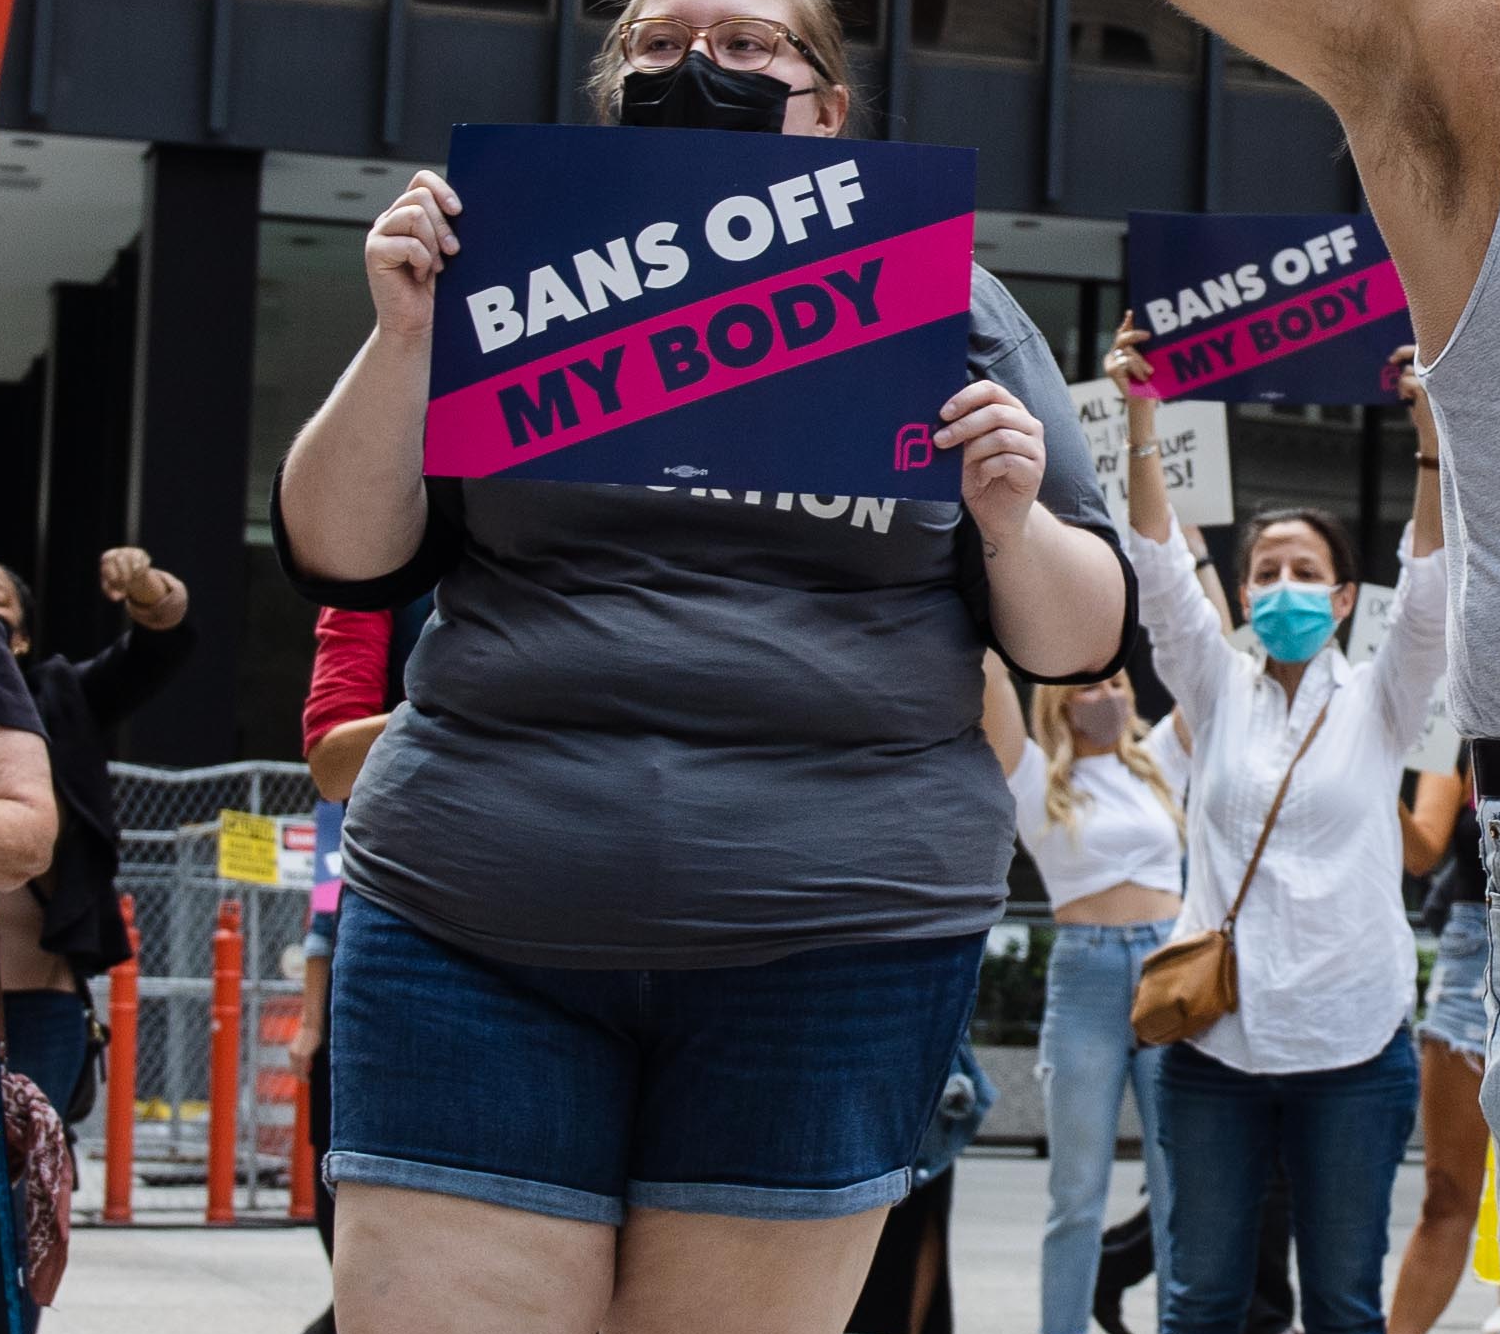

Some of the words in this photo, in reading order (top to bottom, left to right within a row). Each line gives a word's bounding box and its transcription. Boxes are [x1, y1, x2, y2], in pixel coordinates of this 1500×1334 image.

[466, 221, 690, 354] BANS
[705, 159, 864, 261] OFF
[1146, 264, 1267, 336] BANS
[1271, 224, 1358, 285] OFF
[1168, 330, 1237, 384] MY
[1249, 279, 1369, 354] BODY
[497, 344, 626, 449] MY
[649, 257, 885, 393] BODY
